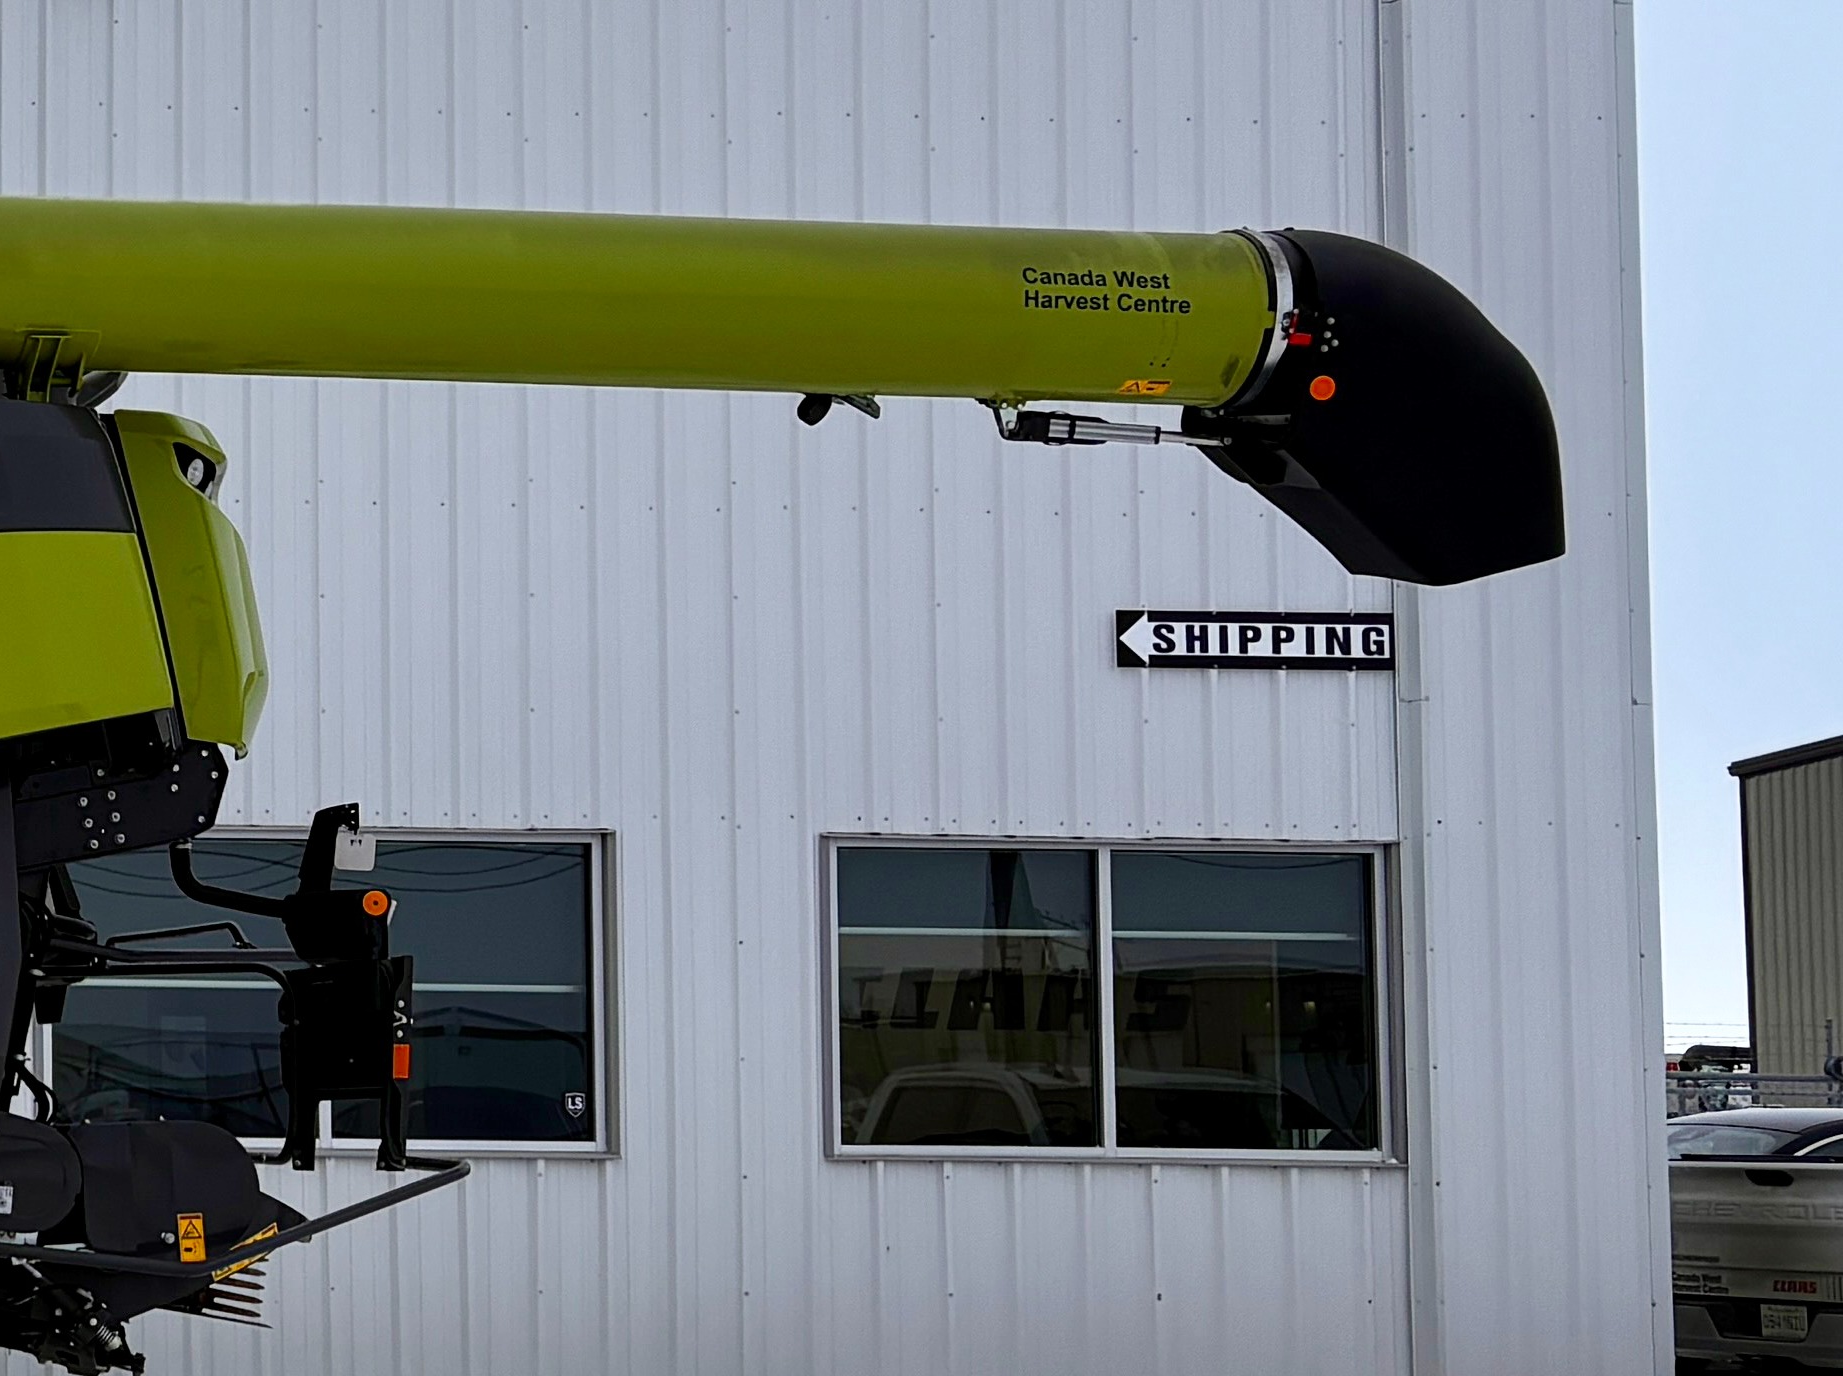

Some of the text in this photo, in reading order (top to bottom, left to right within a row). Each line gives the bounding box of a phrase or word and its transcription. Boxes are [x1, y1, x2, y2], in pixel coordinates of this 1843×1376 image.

[1022, 266, 1171, 290] Canada West
[1024, 289, 1192, 315] Harvest Centre
[1151, 623, 1386, 657] SHIPPING
[568, 1097, 582, 1109] LS
[1673, 1202, 1843, 1221] CHEROL
[1772, 1279, 1818, 1295] CLAAS
